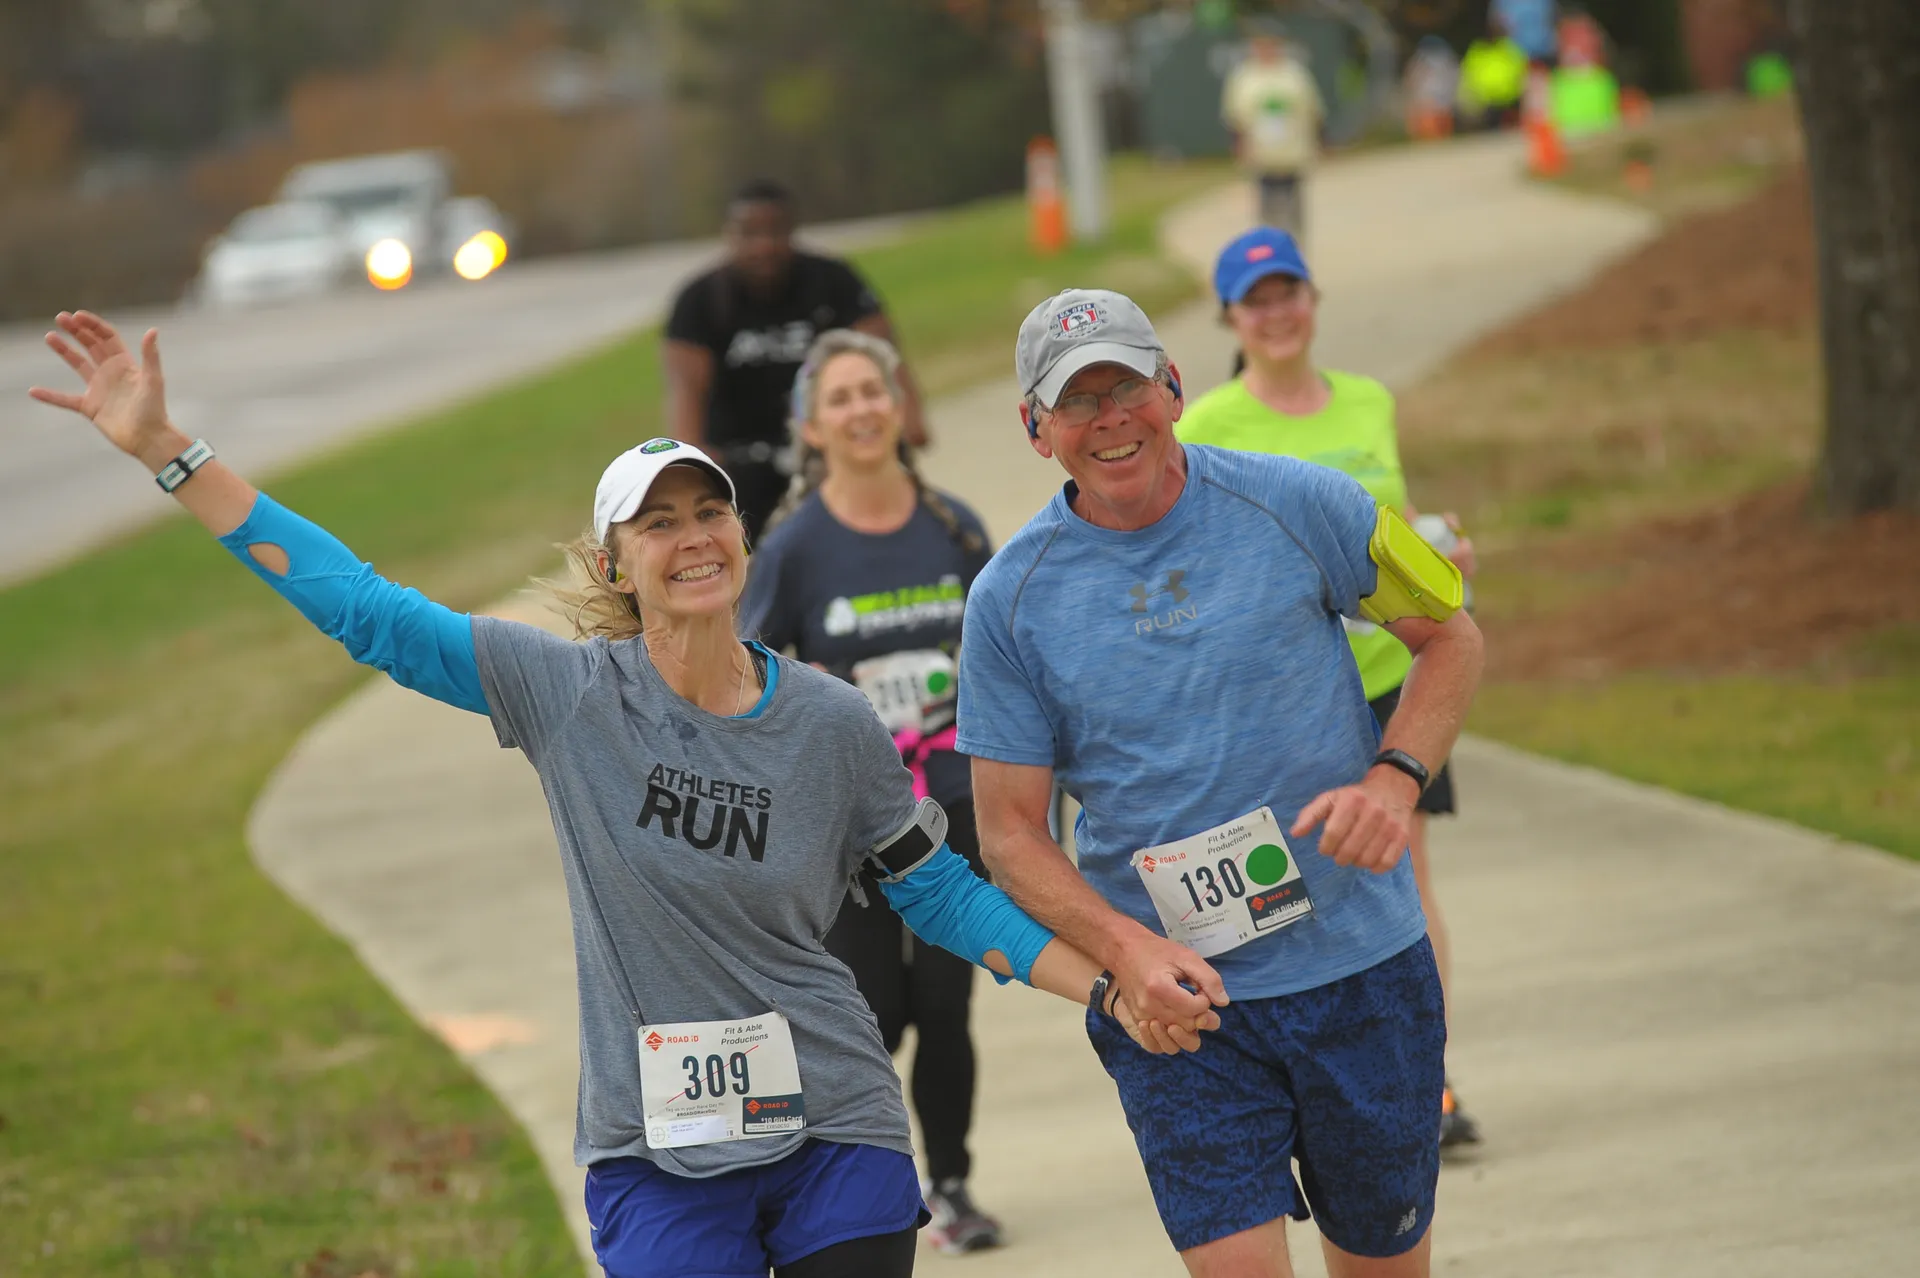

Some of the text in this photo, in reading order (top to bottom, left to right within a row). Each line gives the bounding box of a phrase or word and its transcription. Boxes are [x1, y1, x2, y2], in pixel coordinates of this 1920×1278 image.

[1135, 604, 1197, 636] RUN
[647, 763, 772, 810] ATHLETES
[635, 783, 770, 863] RUN
[1208, 824, 1245, 845] Fit & Able
[1207, 831, 1252, 855] Productions
[1159, 855, 1177, 865] ROAD
[1180, 857, 1246, 913] 130
[667, 1036, 689, 1044] ROAD
[720, 1033, 769, 1046] Productions
[724, 1023, 763, 1035] Fit & Able
[682, 1051, 751, 1101] 309
